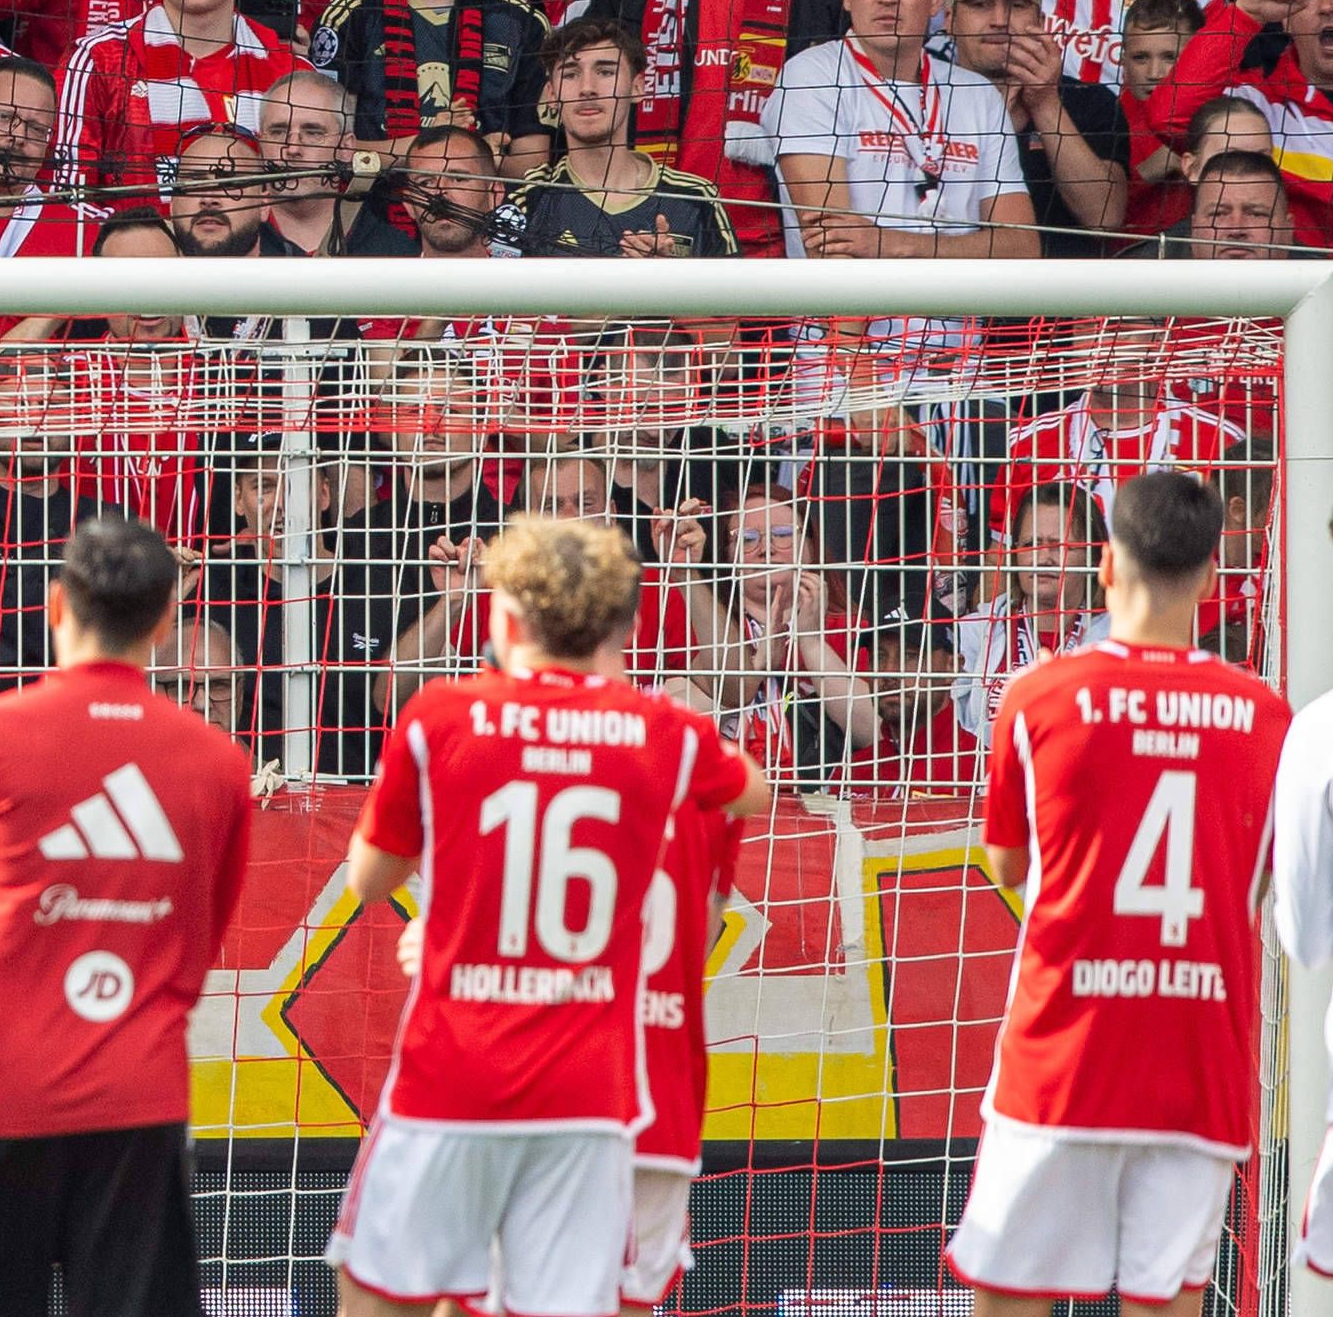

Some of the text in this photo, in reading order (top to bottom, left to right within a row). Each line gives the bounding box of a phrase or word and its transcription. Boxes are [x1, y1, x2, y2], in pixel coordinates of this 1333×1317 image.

[468, 700, 647, 747] 1. FC UNION
[1075, 686, 1255, 735] 1. FC UNION
[521, 745, 593, 775] BERLIN
[1132, 729, 1200, 760] BERLIN
[479, 779, 622, 966] 16
[1112, 769, 1205, 948] 4
[83, 970, 121, 1001] JD
[1071, 957, 1228, 1003] DIOGO LEITE
